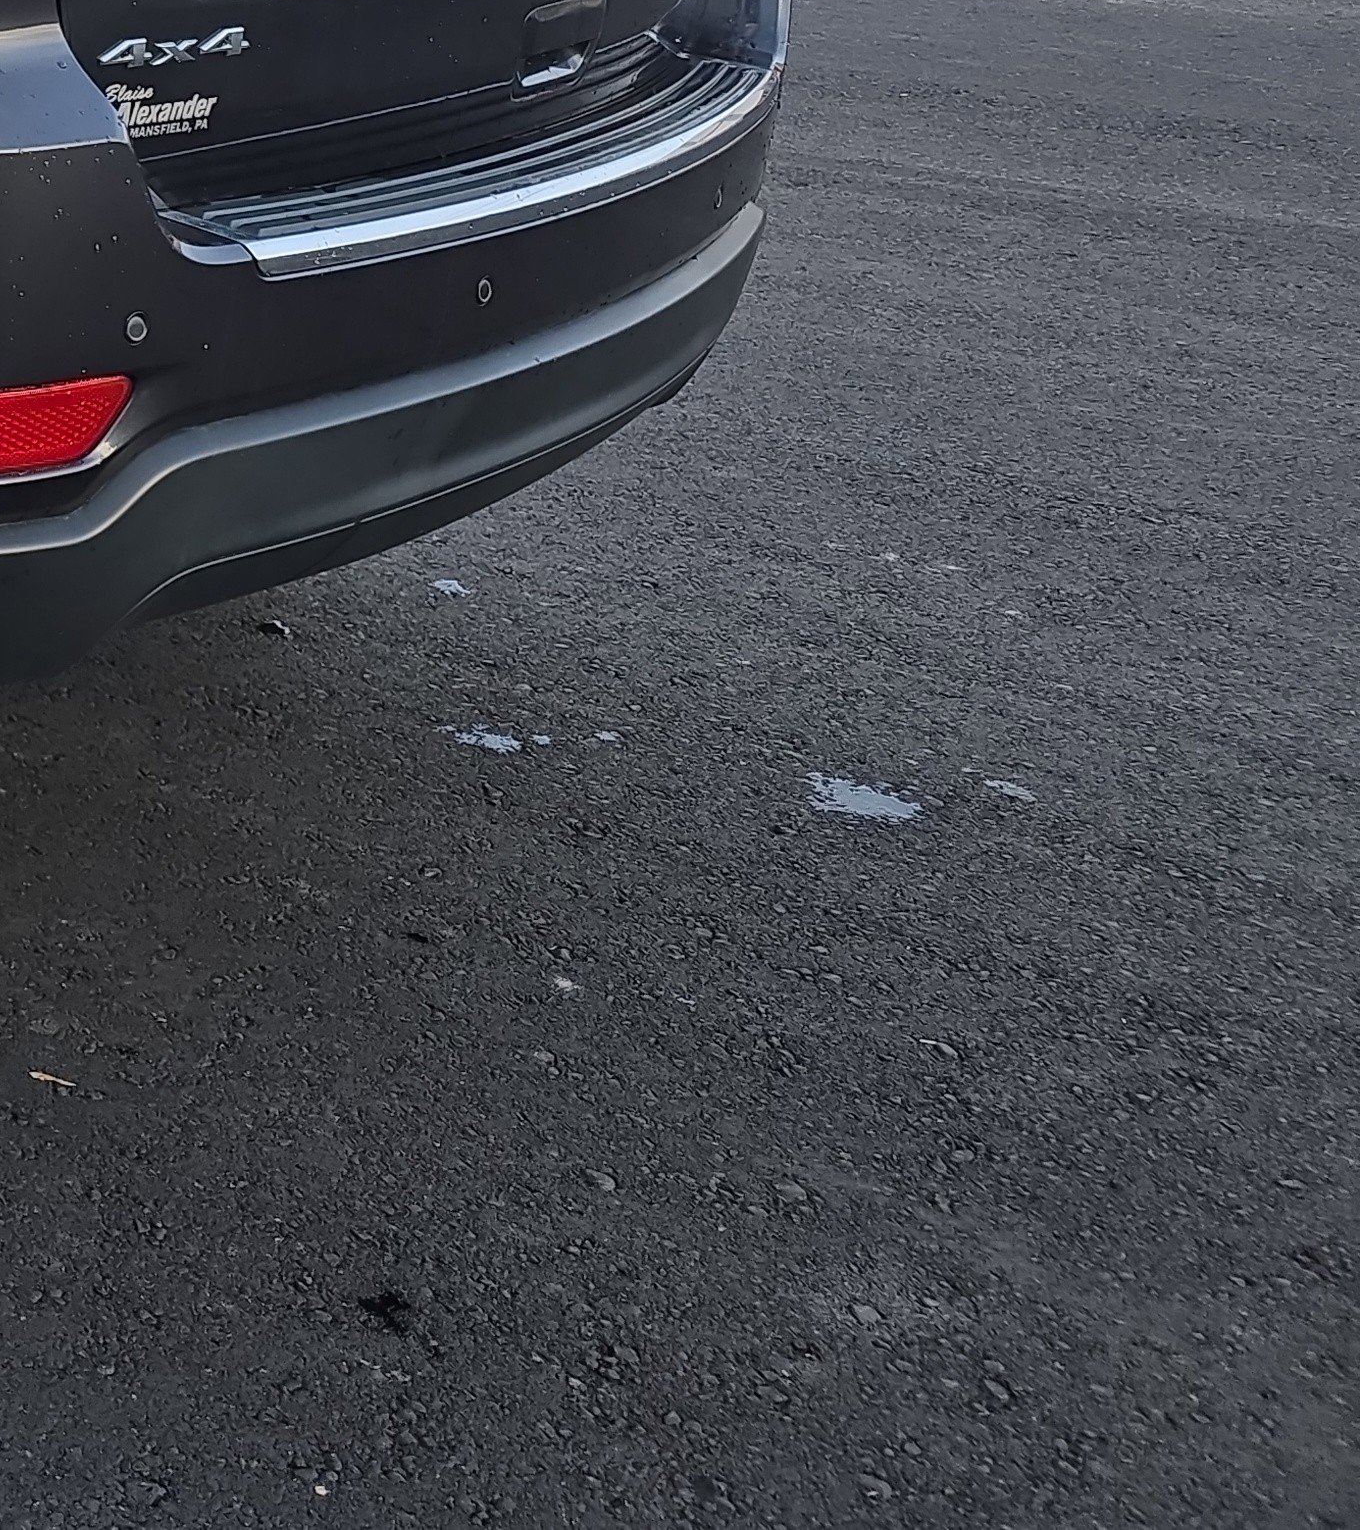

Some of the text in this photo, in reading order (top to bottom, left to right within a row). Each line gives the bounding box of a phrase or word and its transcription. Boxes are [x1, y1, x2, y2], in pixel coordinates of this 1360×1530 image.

[96, 26, 250, 68] 4x4
[105, 83, 154, 103] Blaise
[118, 93, 218, 129] Alexander
[129, 118, 209, 139] MANSFIELD, PA
